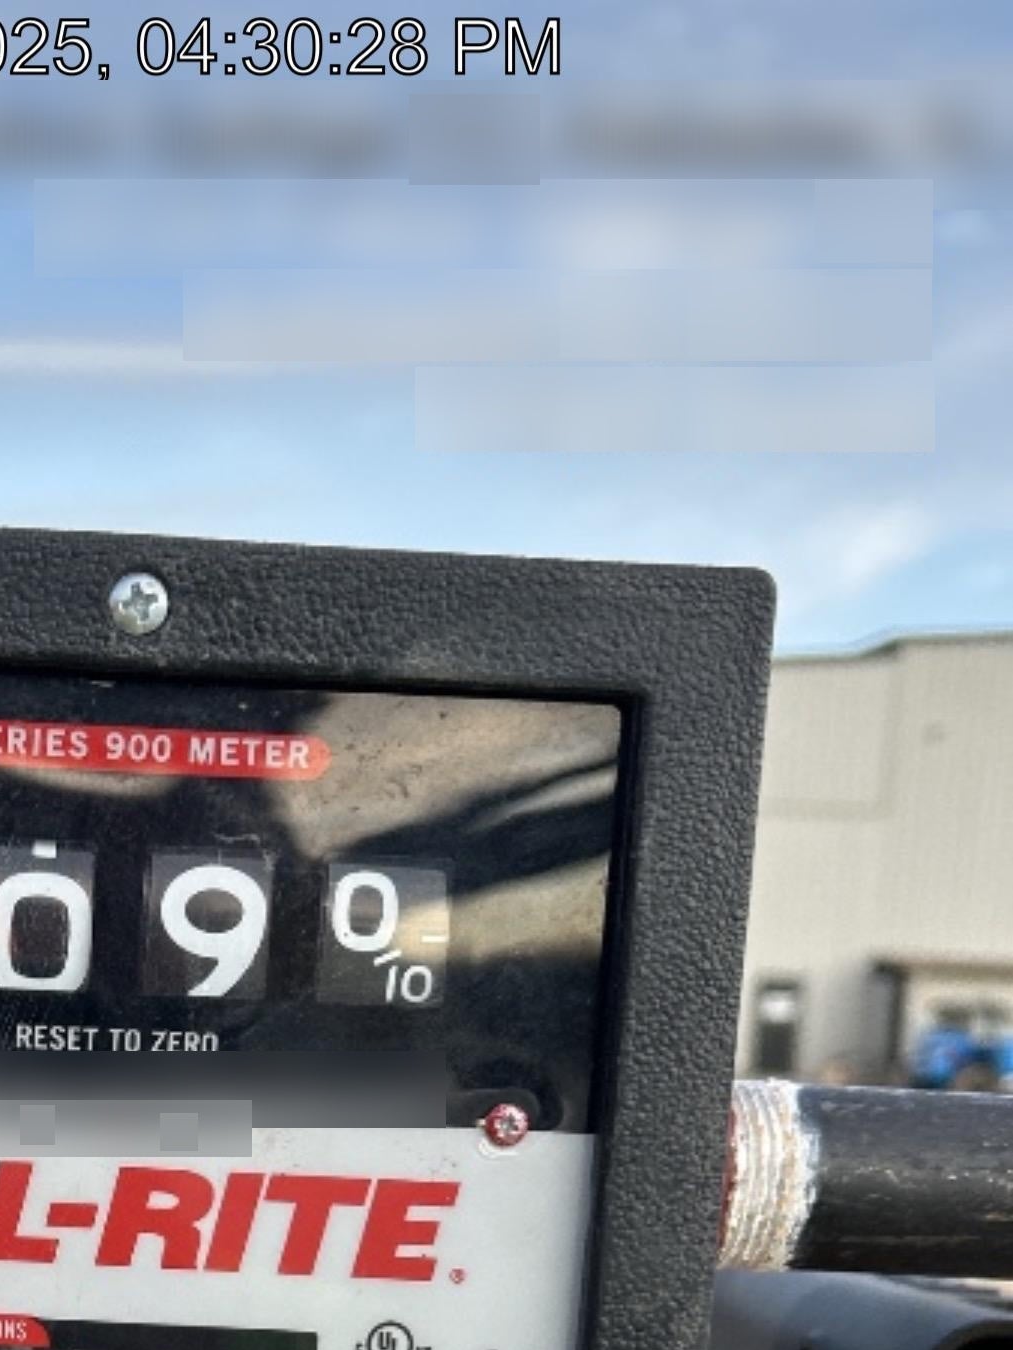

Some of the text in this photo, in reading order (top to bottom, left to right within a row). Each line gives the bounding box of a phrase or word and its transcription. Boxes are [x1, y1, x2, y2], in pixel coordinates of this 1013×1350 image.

[105, 735, 172, 763] 900
[189, 738, 309, 768] METER
[15, 1024, 219, 1051] RESET TO ZERO
